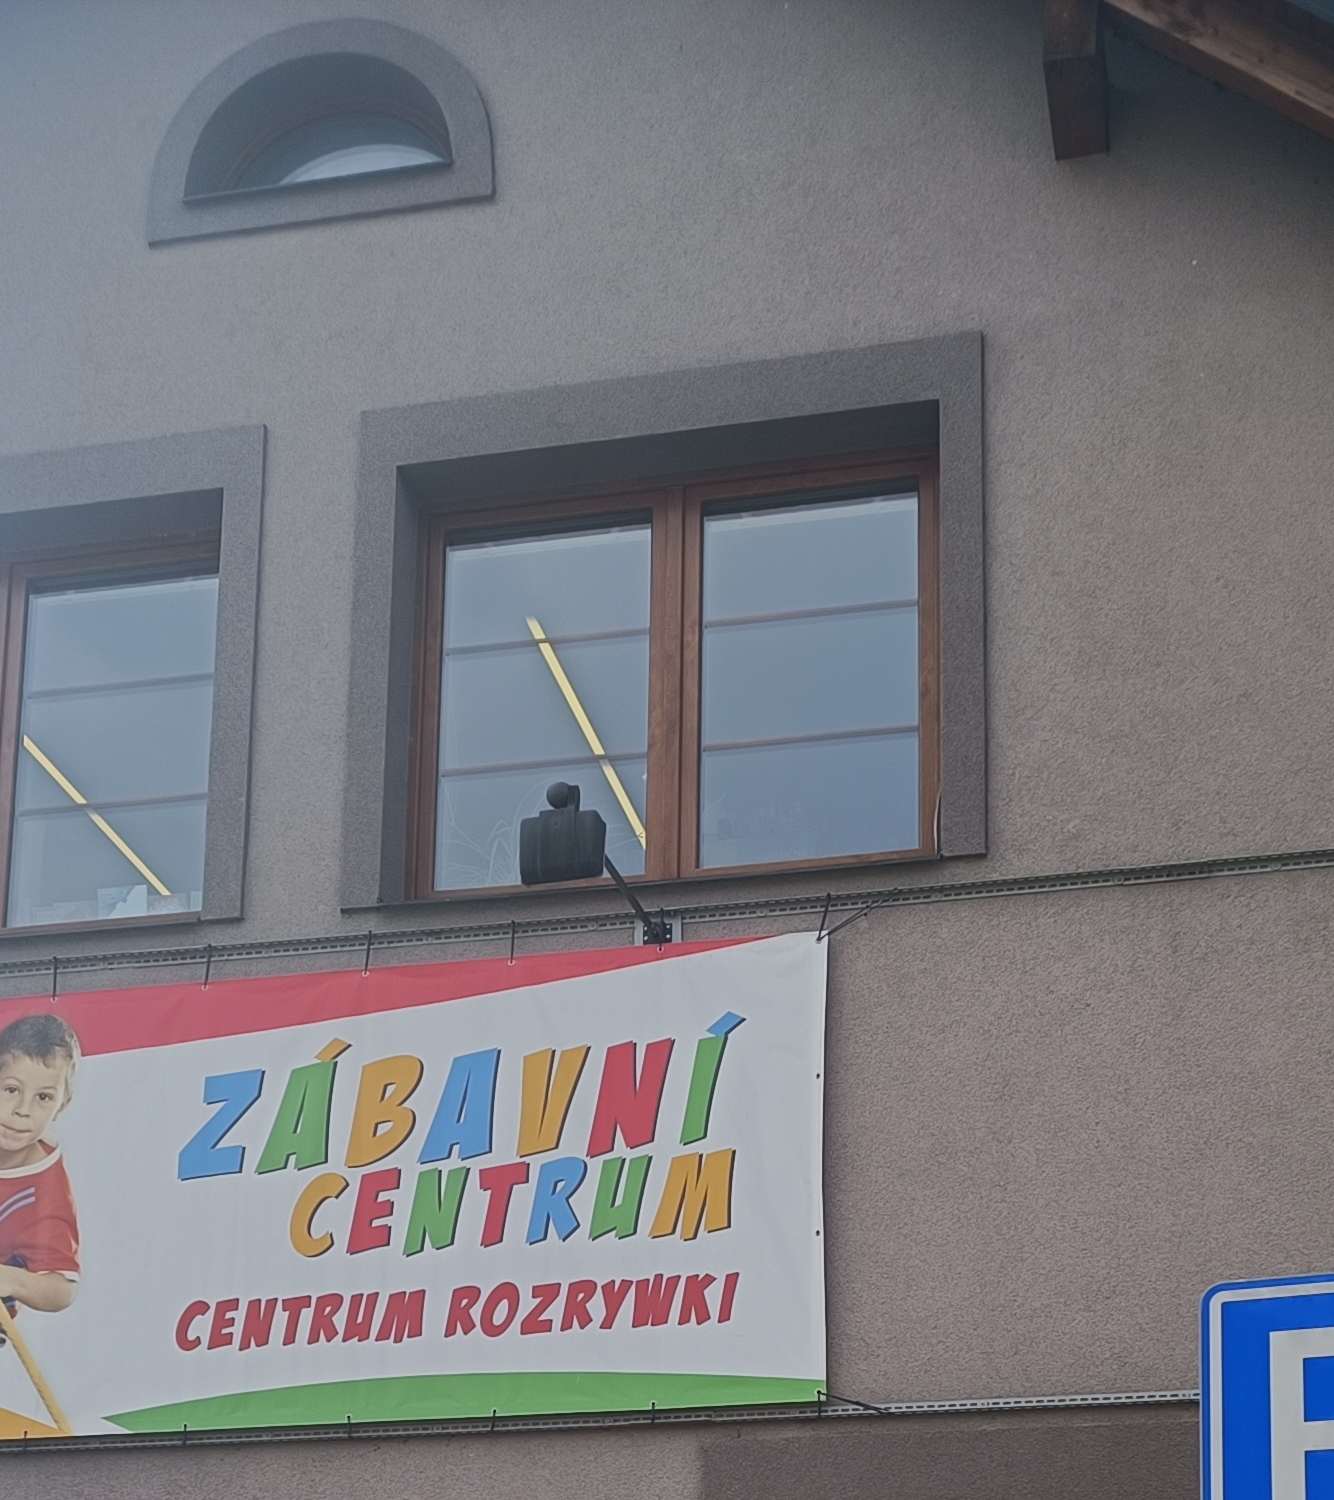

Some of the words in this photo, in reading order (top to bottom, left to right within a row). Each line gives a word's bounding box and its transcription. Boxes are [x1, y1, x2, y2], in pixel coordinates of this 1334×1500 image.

[178, 1011, 746, 1181] ZÁBAVNÍ
[289, 1148, 736, 1258] CENTRUM
[175, 1289, 427, 1352] CENTRUM
[443, 1272, 740, 1339] ROZRYWKI
